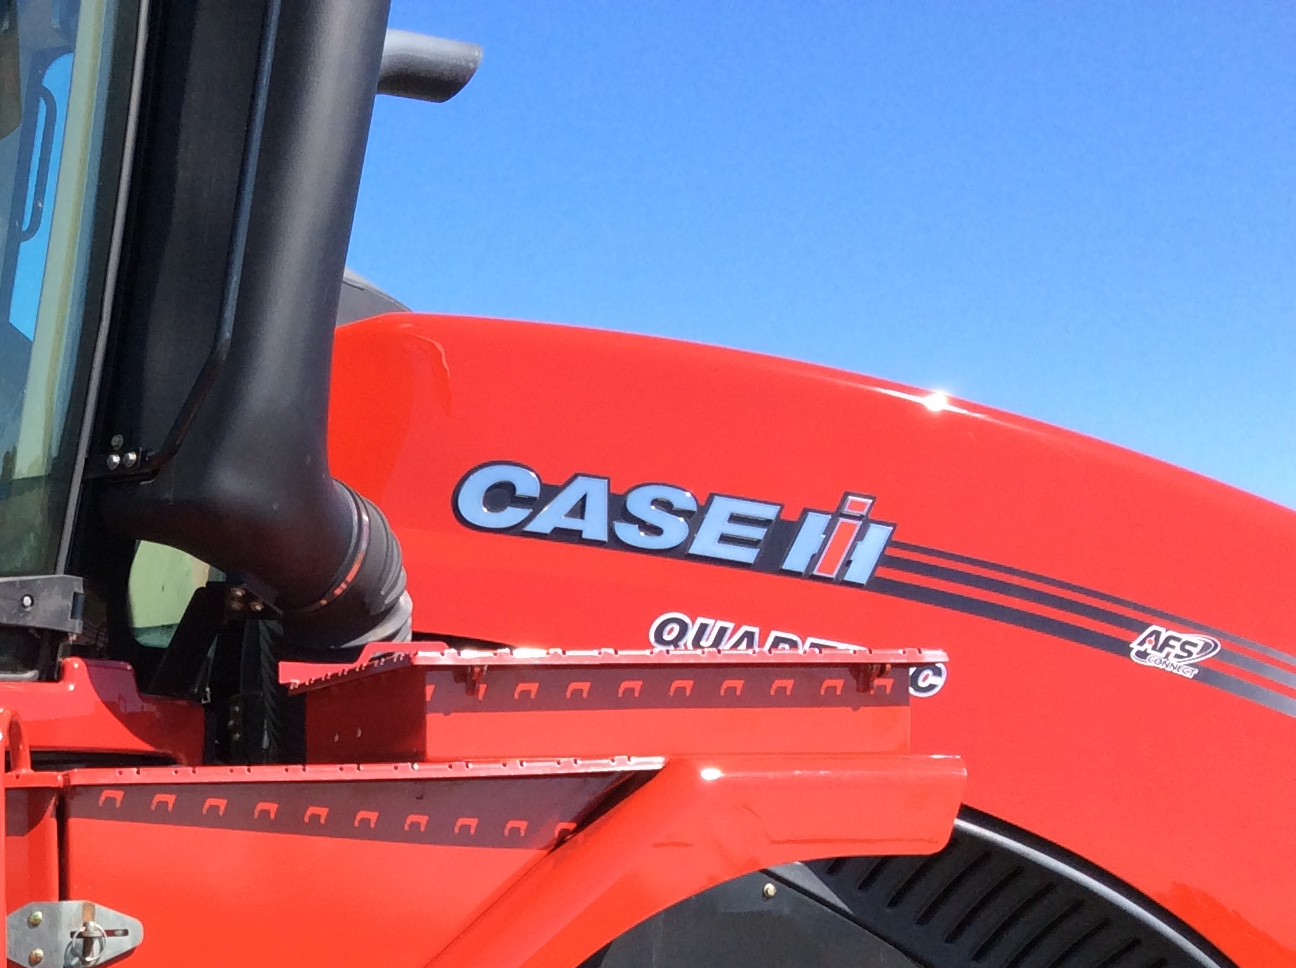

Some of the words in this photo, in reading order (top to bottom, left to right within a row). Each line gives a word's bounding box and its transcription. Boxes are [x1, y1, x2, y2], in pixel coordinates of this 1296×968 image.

[454, 461, 783, 568] CASE
[1135, 628, 1200, 660] AFS
[1147, 654, 1197, 677] CONNECT
